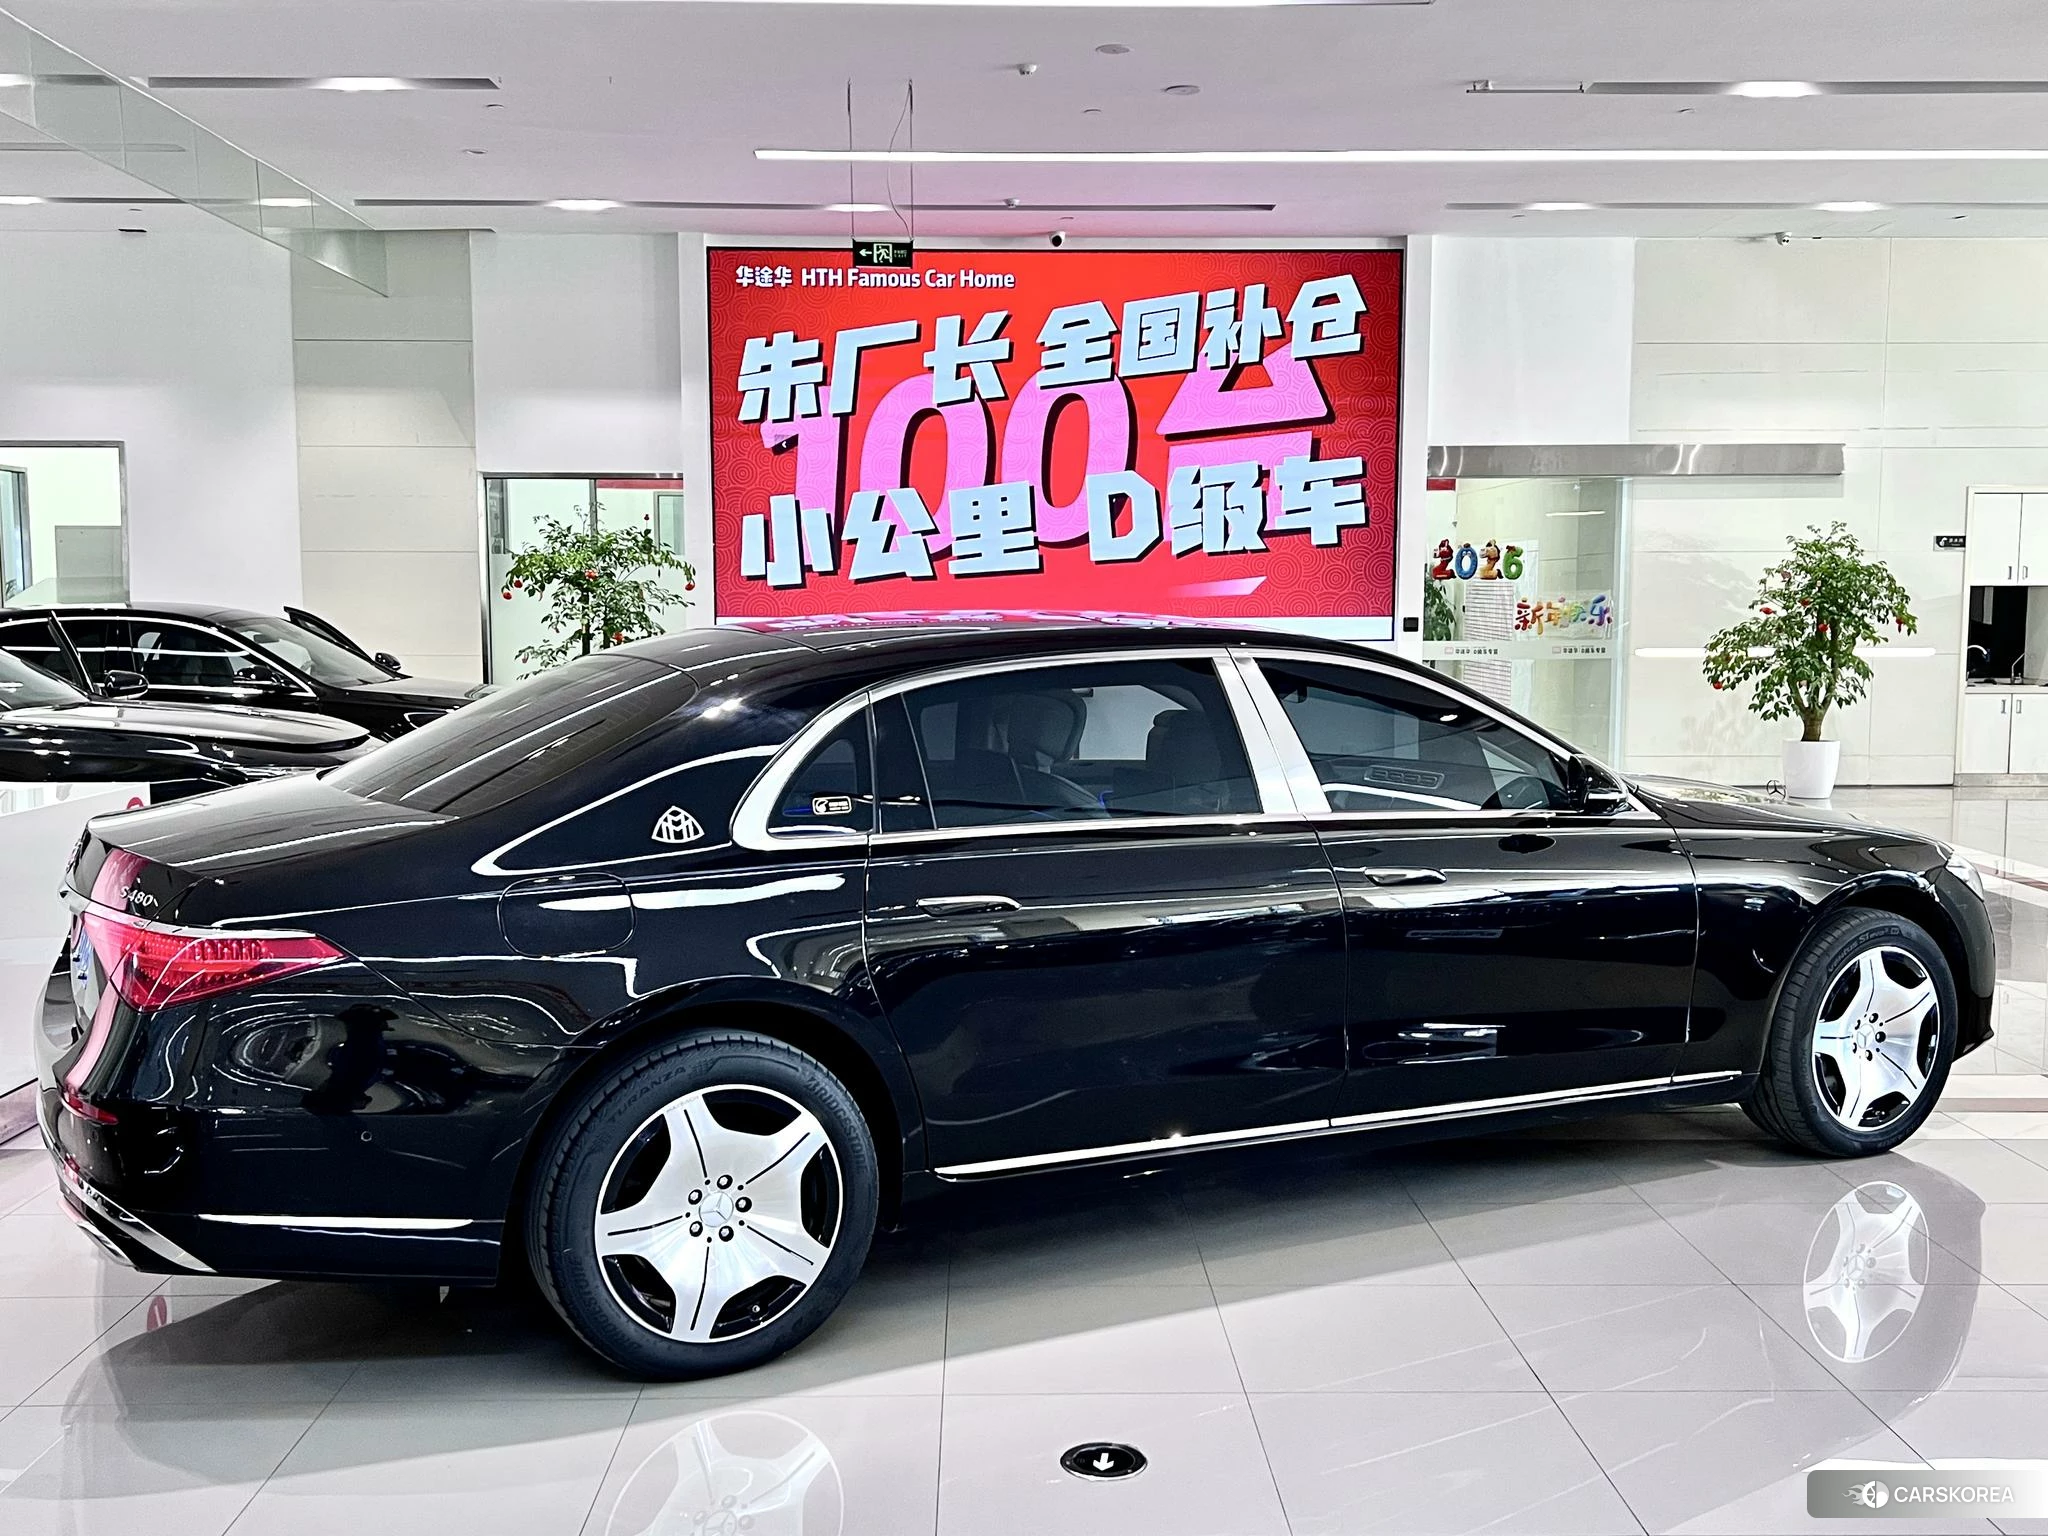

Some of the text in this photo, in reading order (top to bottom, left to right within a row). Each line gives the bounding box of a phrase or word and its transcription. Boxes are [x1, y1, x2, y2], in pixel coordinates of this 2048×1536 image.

[735, 264, 1016, 288] 华途华 HTH Famous Car Home
[737, 274, 1368, 423] 朱厂长 全国补仓
[741, 456, 1369, 589] 小公里 D级车
[1432, 539, 1524, 580] 2026
